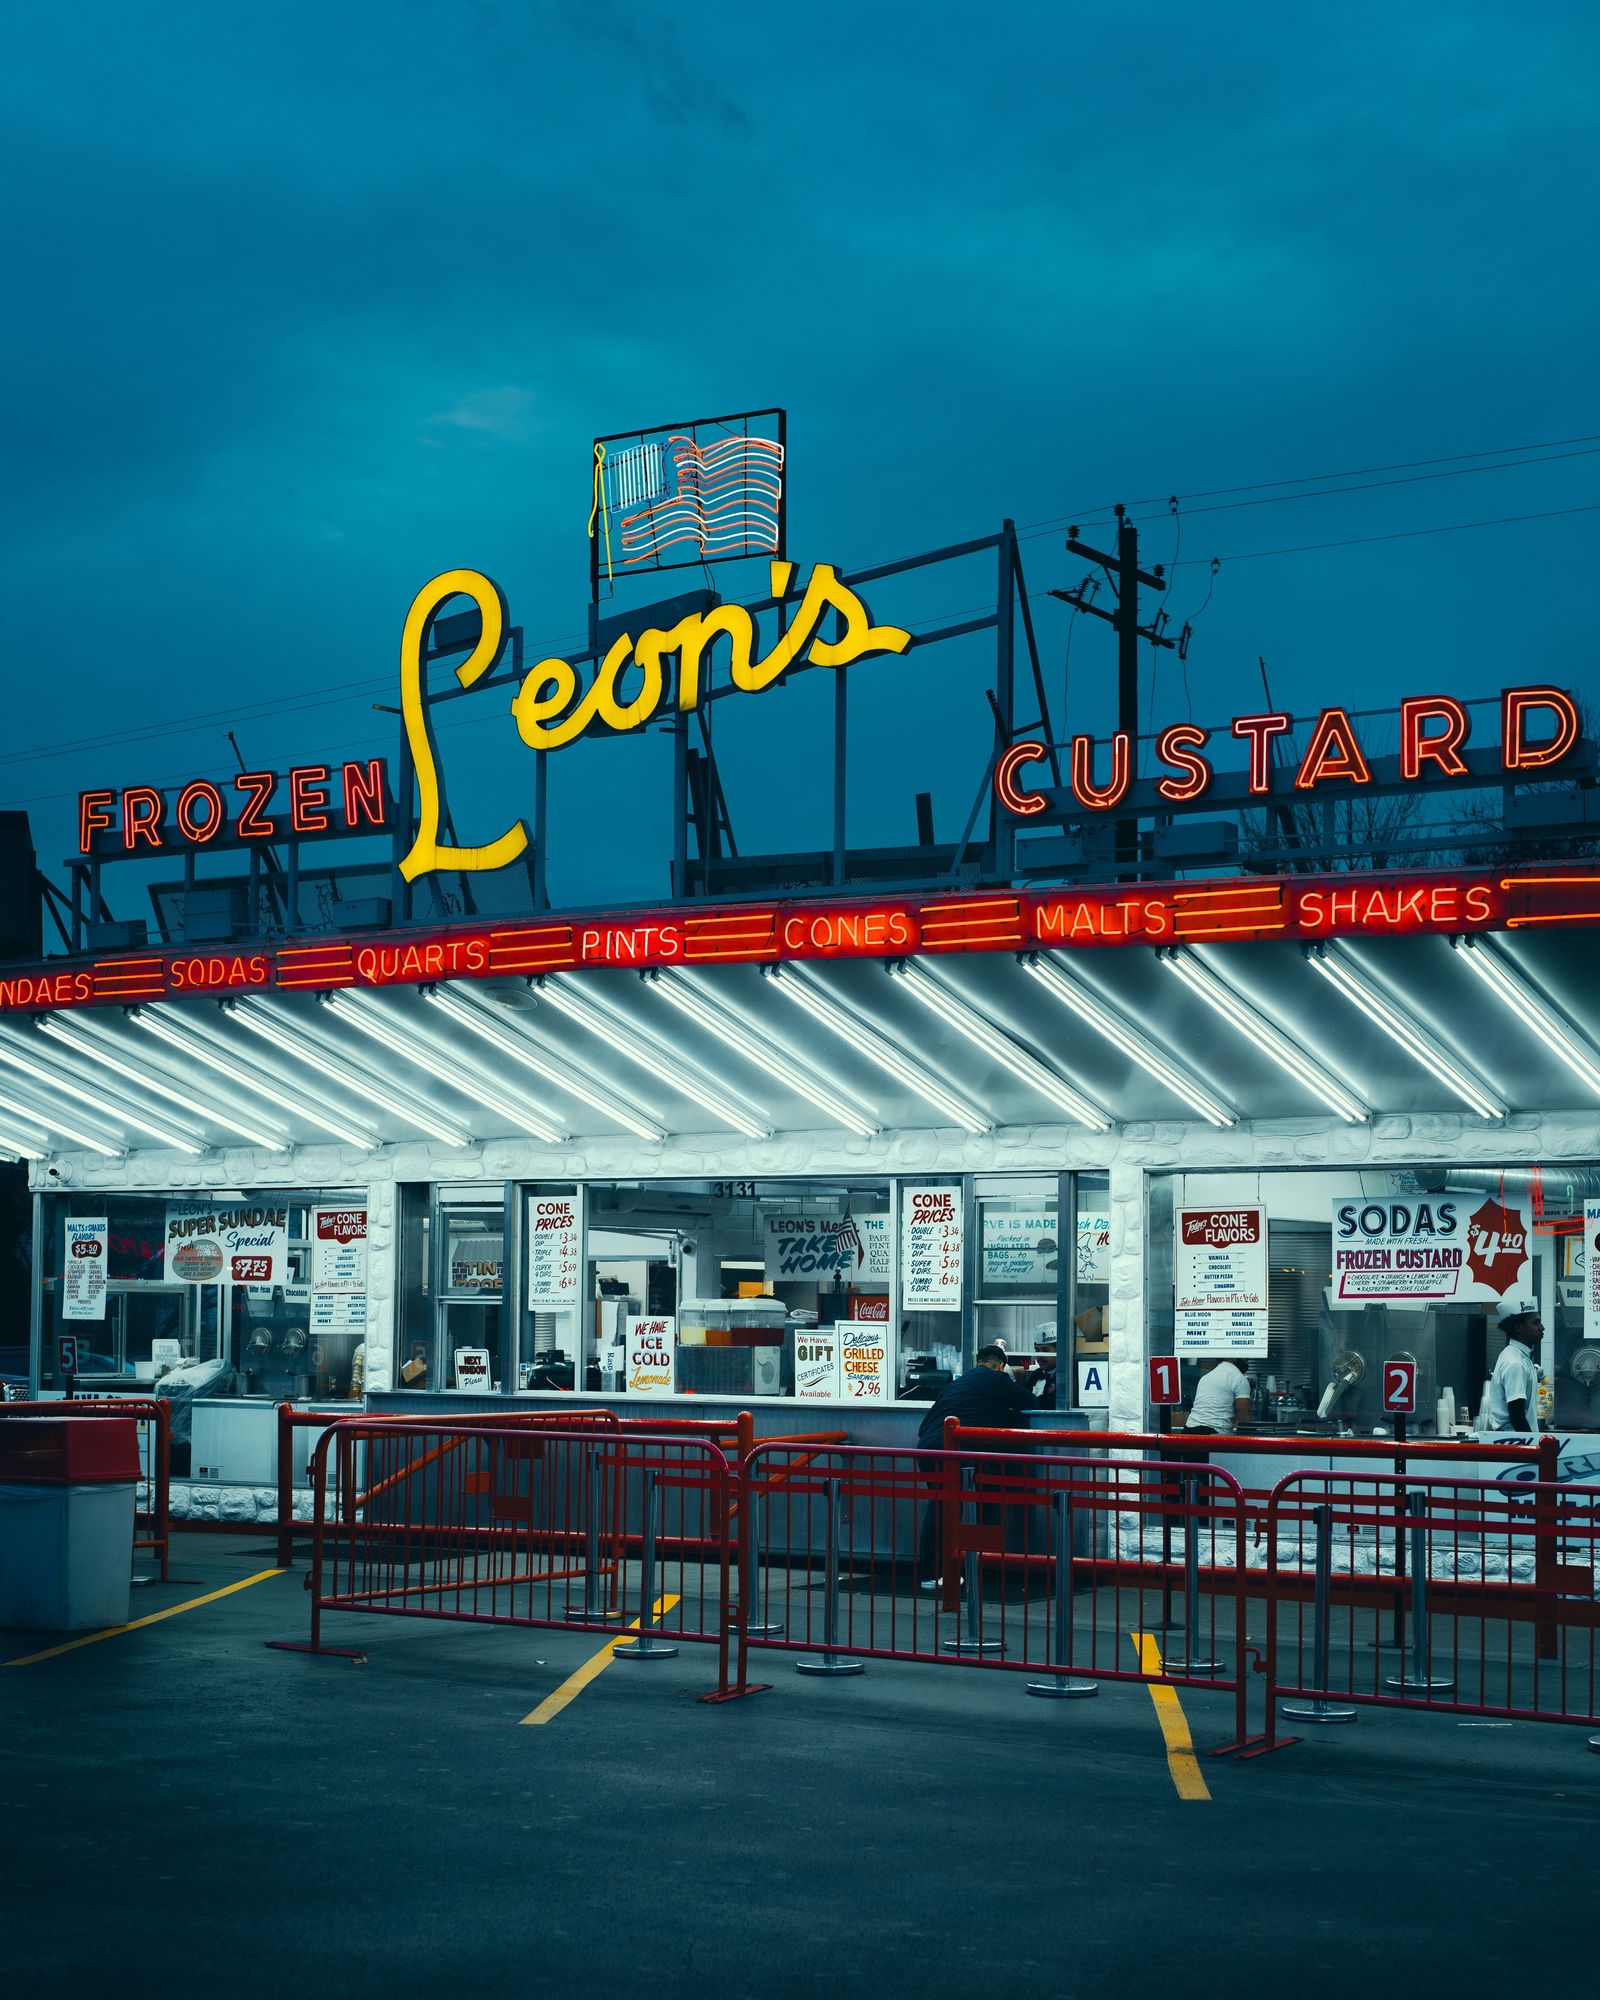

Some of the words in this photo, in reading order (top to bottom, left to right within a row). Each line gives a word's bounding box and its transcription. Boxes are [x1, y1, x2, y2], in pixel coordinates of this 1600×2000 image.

[399, 561, 911, 883] Leon's
[994, 688, 1577, 814] CUSTARD
[79, 758, 387, 853] FROZEN
[170, 957, 266, 988] SODAS
[357, 940, 486, 982] QUARTS
[581, 927, 679, 960] PINTS
[784, 913, 907, 950] CONES
[1035, 901, 1167, 940] MALTS
[1299, 886, 1492, 927] SHAKES
[715, 1181, 755, 1198] 3131
[912, 1194, 951, 1207] CONE
[179, 1203, 213, 1215] LEON'S
[536, 1203, 570, 1215] CONE
[337, 1213, 363, 1224] CONE
[535, 1215, 574, 1231] PRICES
[911, 1208, 955, 1225] PRICES
[1210, 1213, 1248, 1227] CONE
[1338, 1202, 1457, 1238] SODAS
[168, 1215, 217, 1242] SUPER
[218, 1207, 287, 1236] SUNDAE
[333, 1225, 367, 1235] FLAVORS
[770, 1219, 816, 1234] LEON'S
[864, 1220, 885, 1229] THE
[911, 1227, 934, 1235] DOUBLE
[1009, 1220, 1021, 1229] IS
[1025, 1219, 1057, 1229] MADE
[225, 1231, 275, 1252] Special
[1205, 1228, 1256, 1242] FLAVORS
[778, 1234, 838, 1256] TAKE
[780, 1249, 856, 1274] HOME
[1336, 1249, 1391, 1269] FROZEN
[1395, 1248, 1463, 1268] CUSTARD
[466, 1261, 496, 1275] TIN
[286, 1289, 308, 1297] Chocolate
[1206, 1293, 1225, 1303] Flavors
[1567, 1288, 1583, 1297] Butter
[635, 1322, 650, 1336] WE
[649, 1320, 669, 1335] HAVE
[641, 1336, 663, 1349] ICE
[797, 1336, 808, 1344] We
[842, 1331, 881, 1346] Delicious
[62, 1343, 73, 1369] 5
[632, 1352, 670, 1366] COLD
[797, 1345, 834, 1361] GIFT
[843, 1347, 884, 1360] GRILLED
[464, 1356, 481, 1365] NEXT
[844, 1361, 879, 1373] CHEESE
[458, 1365, 486, 1374] WINDOW
[796, 1362, 835, 1382] CERTIFICATES
[464, 1377, 483, 1387] Please
[629, 1366, 672, 1391] Lemonade
[846, 1373, 881, 1381] SANDWICH
[1084, 1367, 1103, 1391] A
[1156, 1365, 1169, 1394] 1
[1389, 1369, 1409, 1403] 2
[800, 1389, 831, 1398] Available
